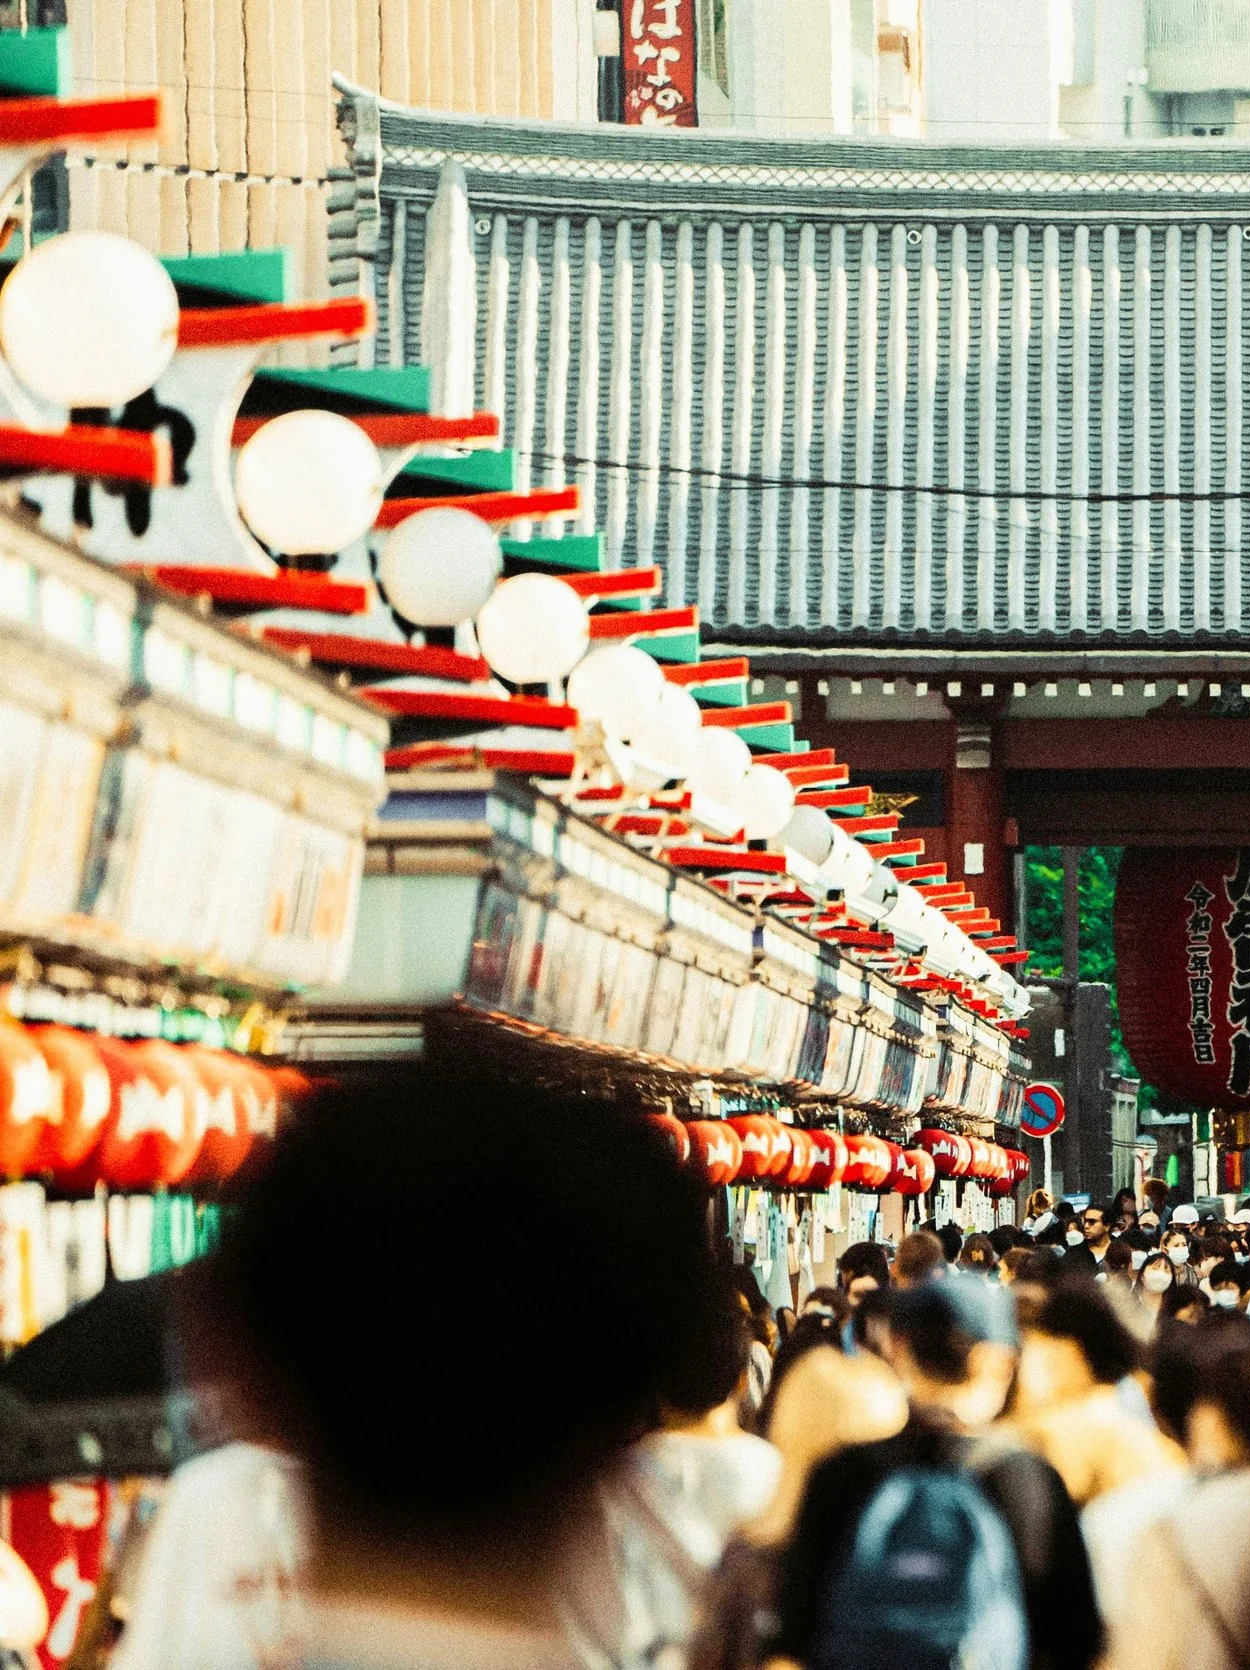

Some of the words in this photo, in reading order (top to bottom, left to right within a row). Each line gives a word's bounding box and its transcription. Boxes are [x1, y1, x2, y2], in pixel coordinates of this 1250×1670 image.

[630, 0, 684, 126] はなの
[1184, 881, 1217, 1064] 令和二年四月吉日
